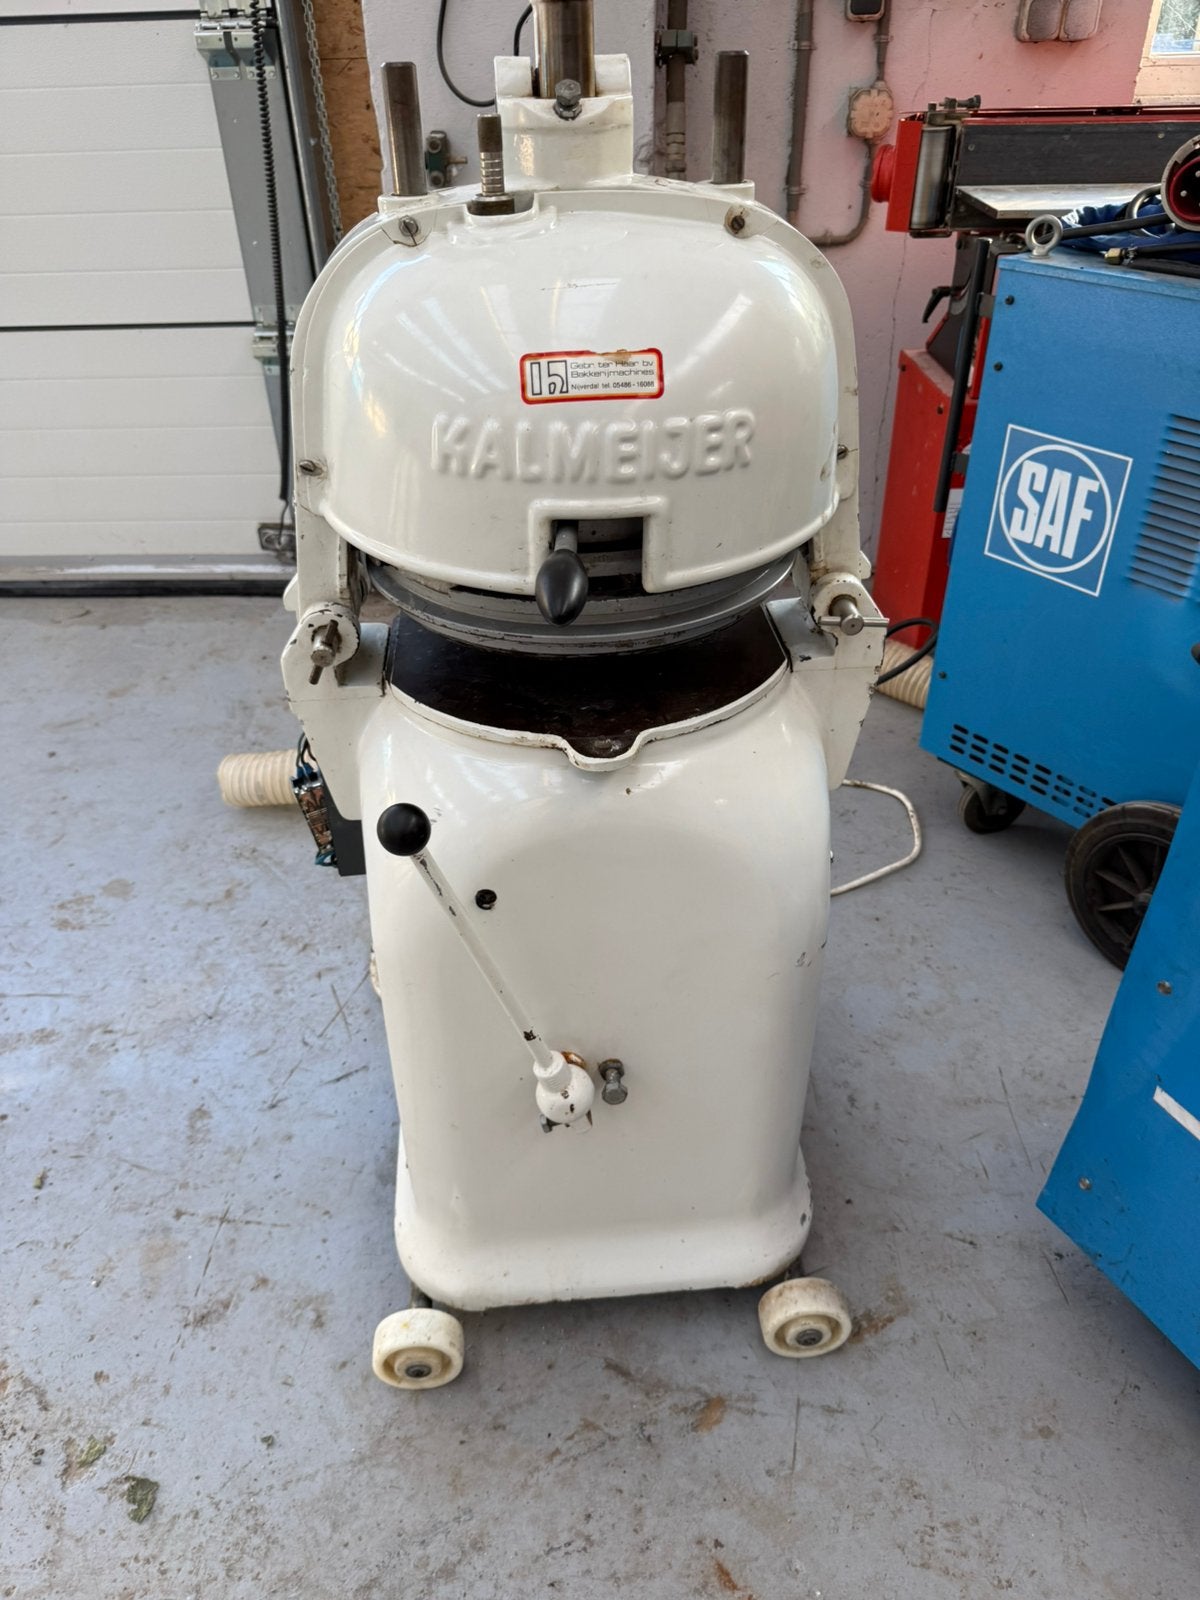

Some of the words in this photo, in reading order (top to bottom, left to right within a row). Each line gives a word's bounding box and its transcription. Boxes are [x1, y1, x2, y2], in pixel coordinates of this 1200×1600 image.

[570, 369, 654, 378] Bakkerijmachines
[615, 359, 640, 367] Haar
[642, 359, 654, 367] bv
[431, 409, 755, 484] KALMEIJER
[1009, 459, 1101, 560] SAF
